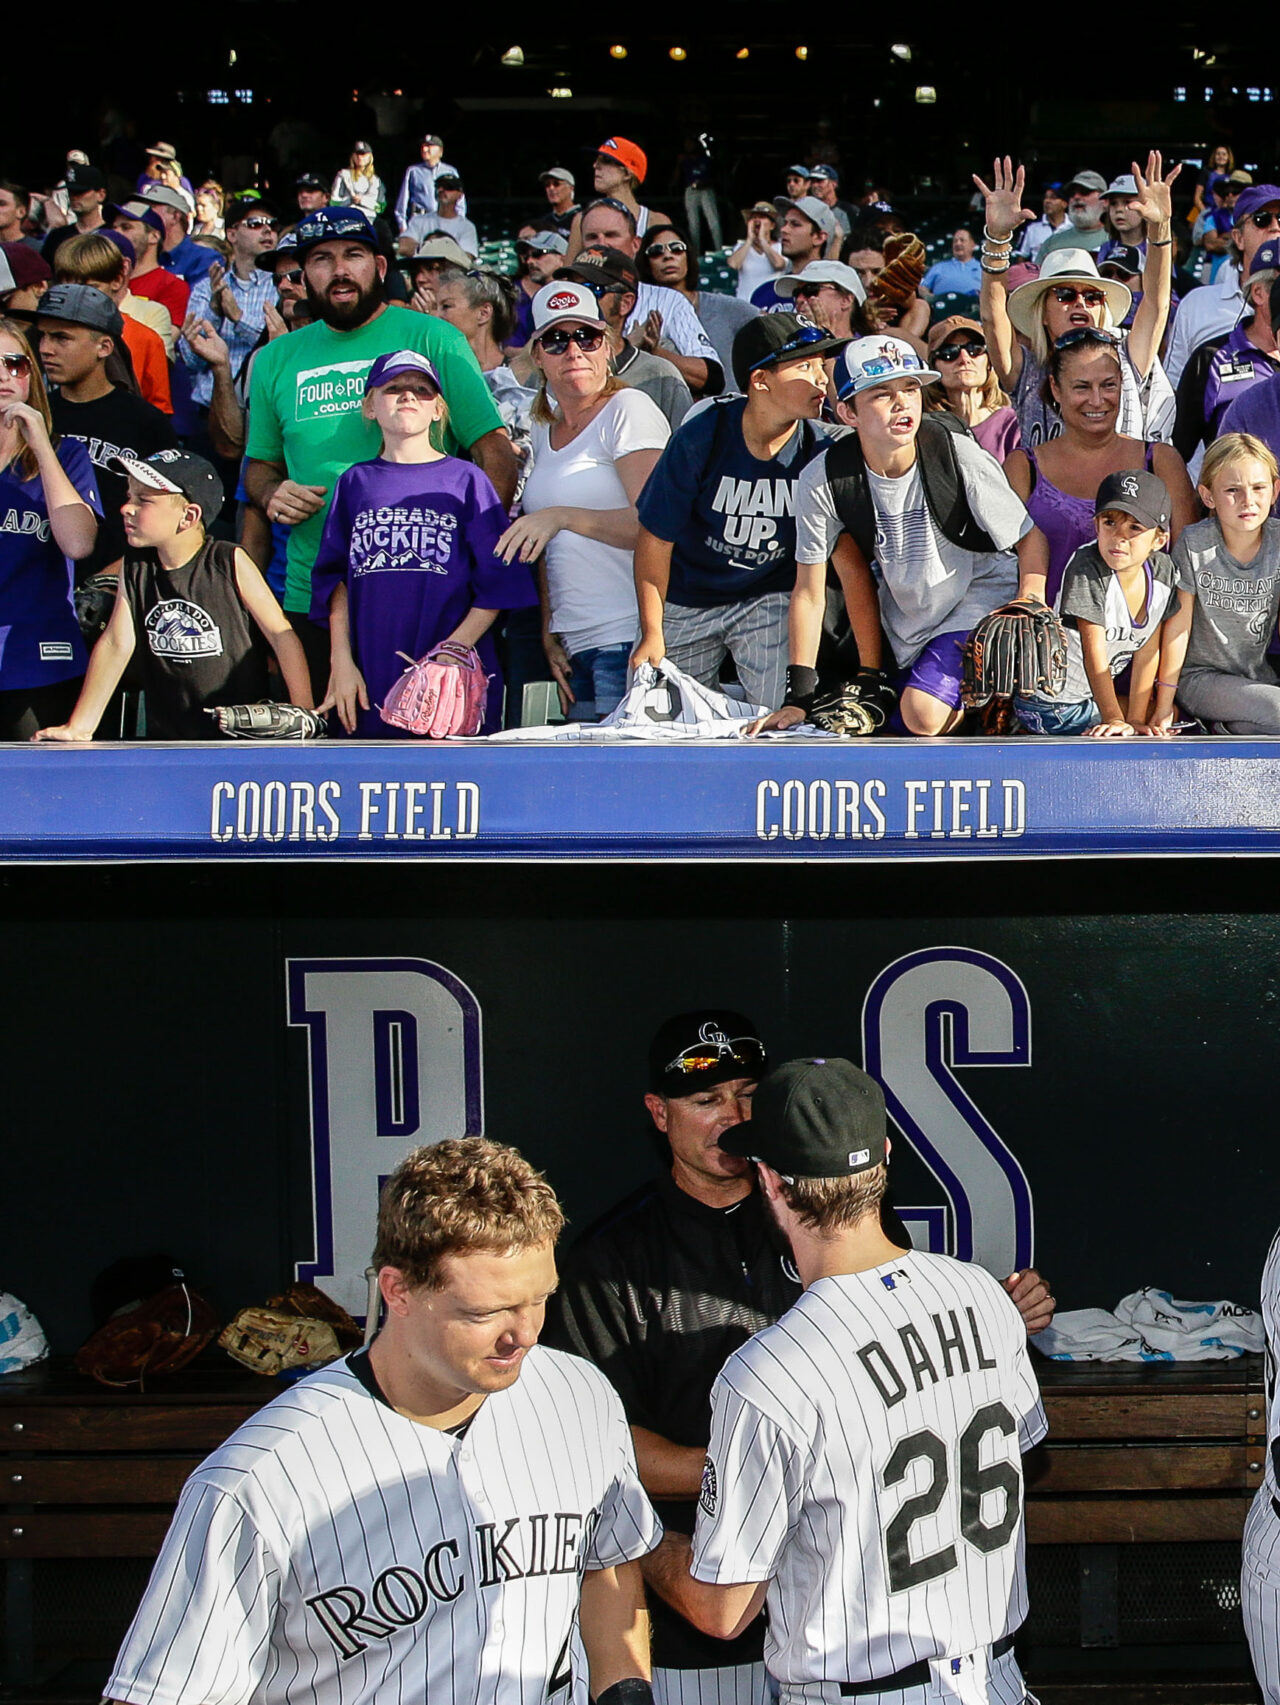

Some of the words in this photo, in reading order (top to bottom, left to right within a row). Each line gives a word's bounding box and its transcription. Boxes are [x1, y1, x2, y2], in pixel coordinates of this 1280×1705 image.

[300, 381, 334, 406] FOUR
[711, 475, 800, 517] MAN
[0, 508, 51, 542] ADO
[351, 507, 458, 533] OLORADO
[723, 515, 779, 550] UP.
[704, 536, 744, 559] JUST
[744, 550, 769, 565] DO
[149, 632, 218, 652] ROCKIES
[210, 780, 341, 843] COORS
[357, 781, 481, 841] FIELD
[756, 779, 887, 841] COORS
[904, 779, 1027, 839] FIELD
[855, 1305, 998, 1410] DAHL
[875, 1398, 1021, 1596] 26
